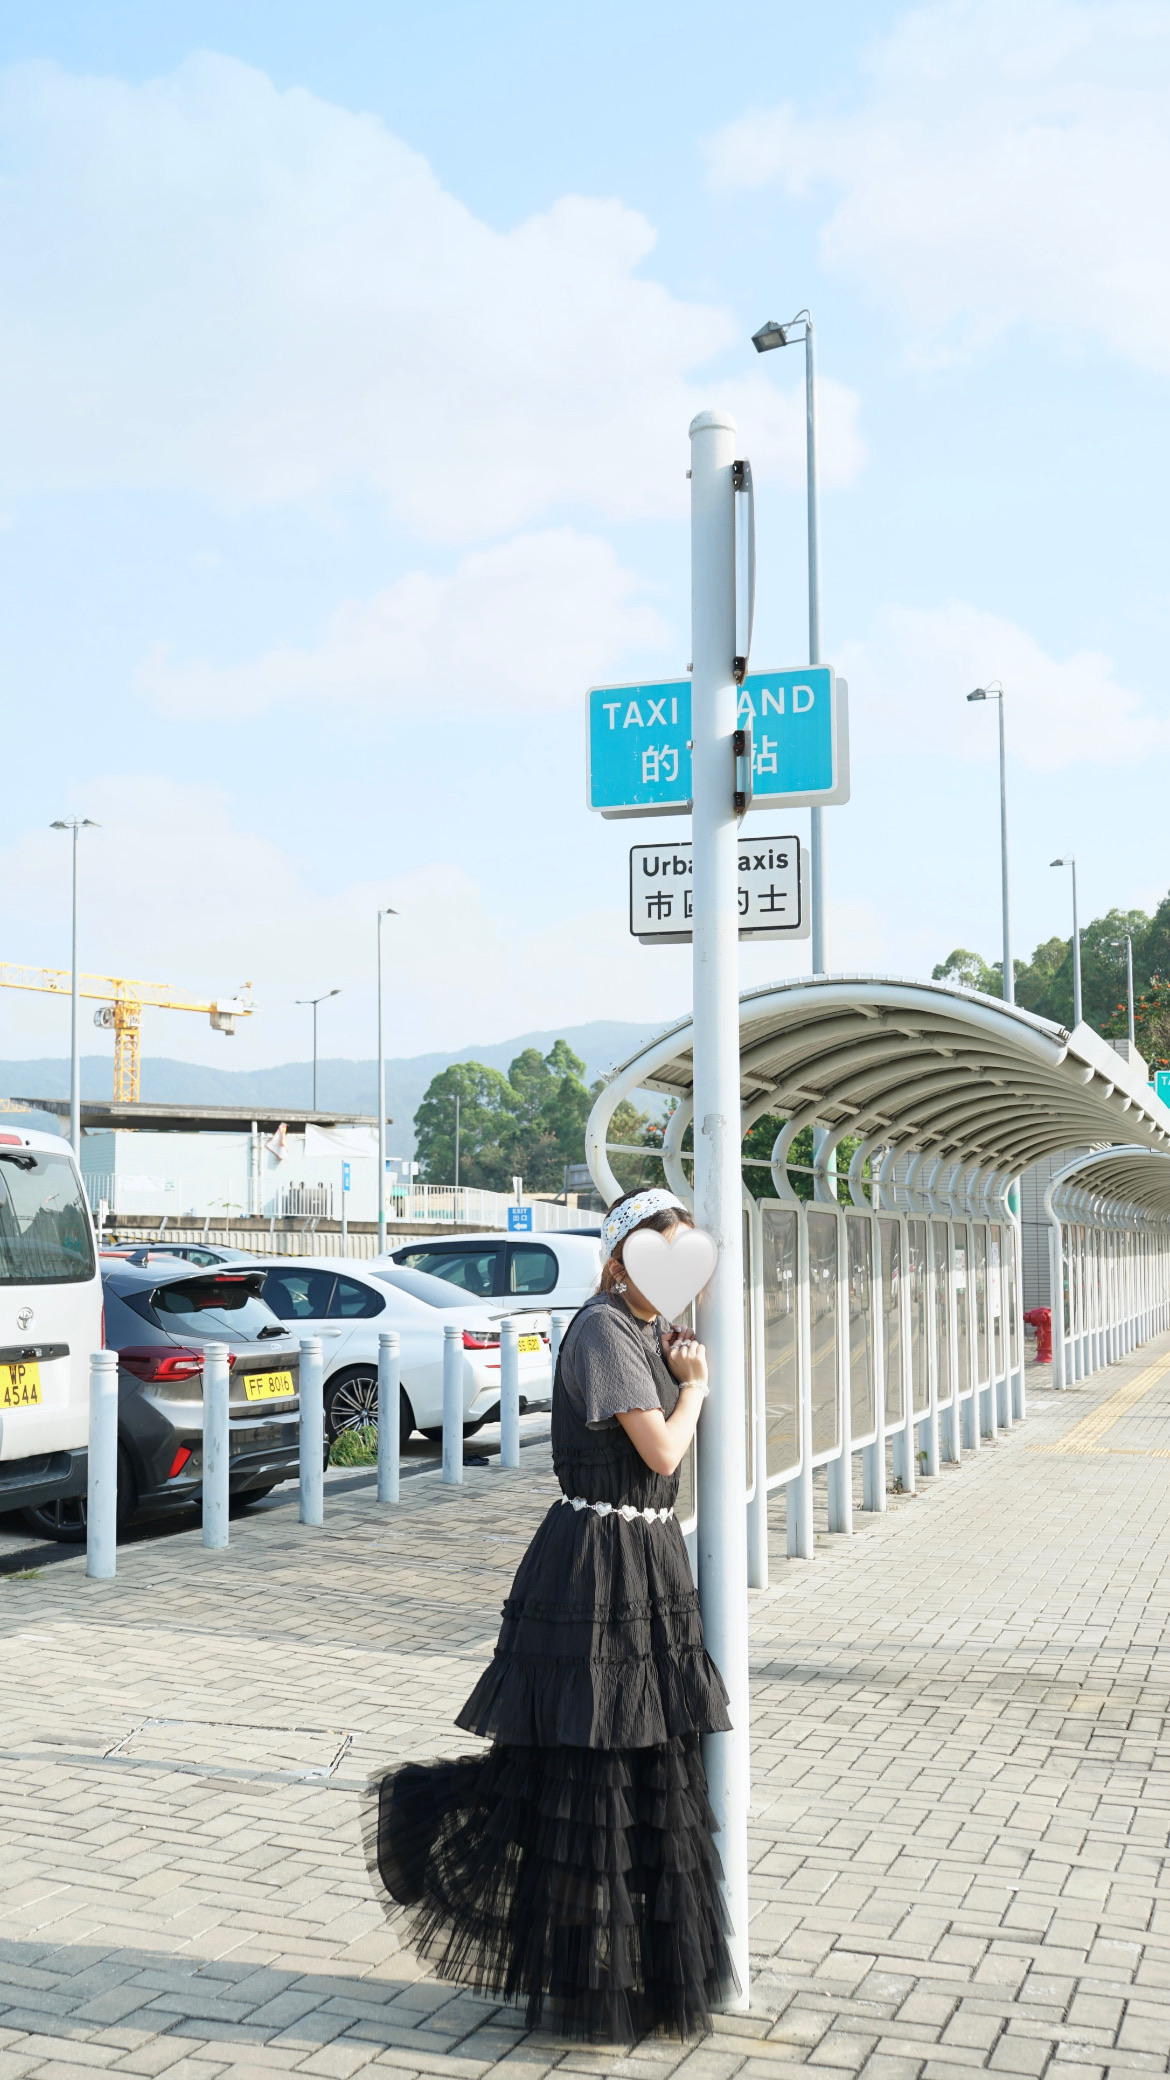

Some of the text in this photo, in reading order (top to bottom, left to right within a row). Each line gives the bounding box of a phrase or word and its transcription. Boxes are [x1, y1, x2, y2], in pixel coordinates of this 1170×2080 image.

[602, 685, 815, 730] TAXI AND
[642, 734, 778, 784] 的站
[642, 848, 789, 877] Urb axis
[512, 1214, 528, 1222] 出口
[9, 1364, 26, 1385] WP
[249, 1376, 290, 1396] FF 8016
[4, 1383, 38, 1406] 4544
